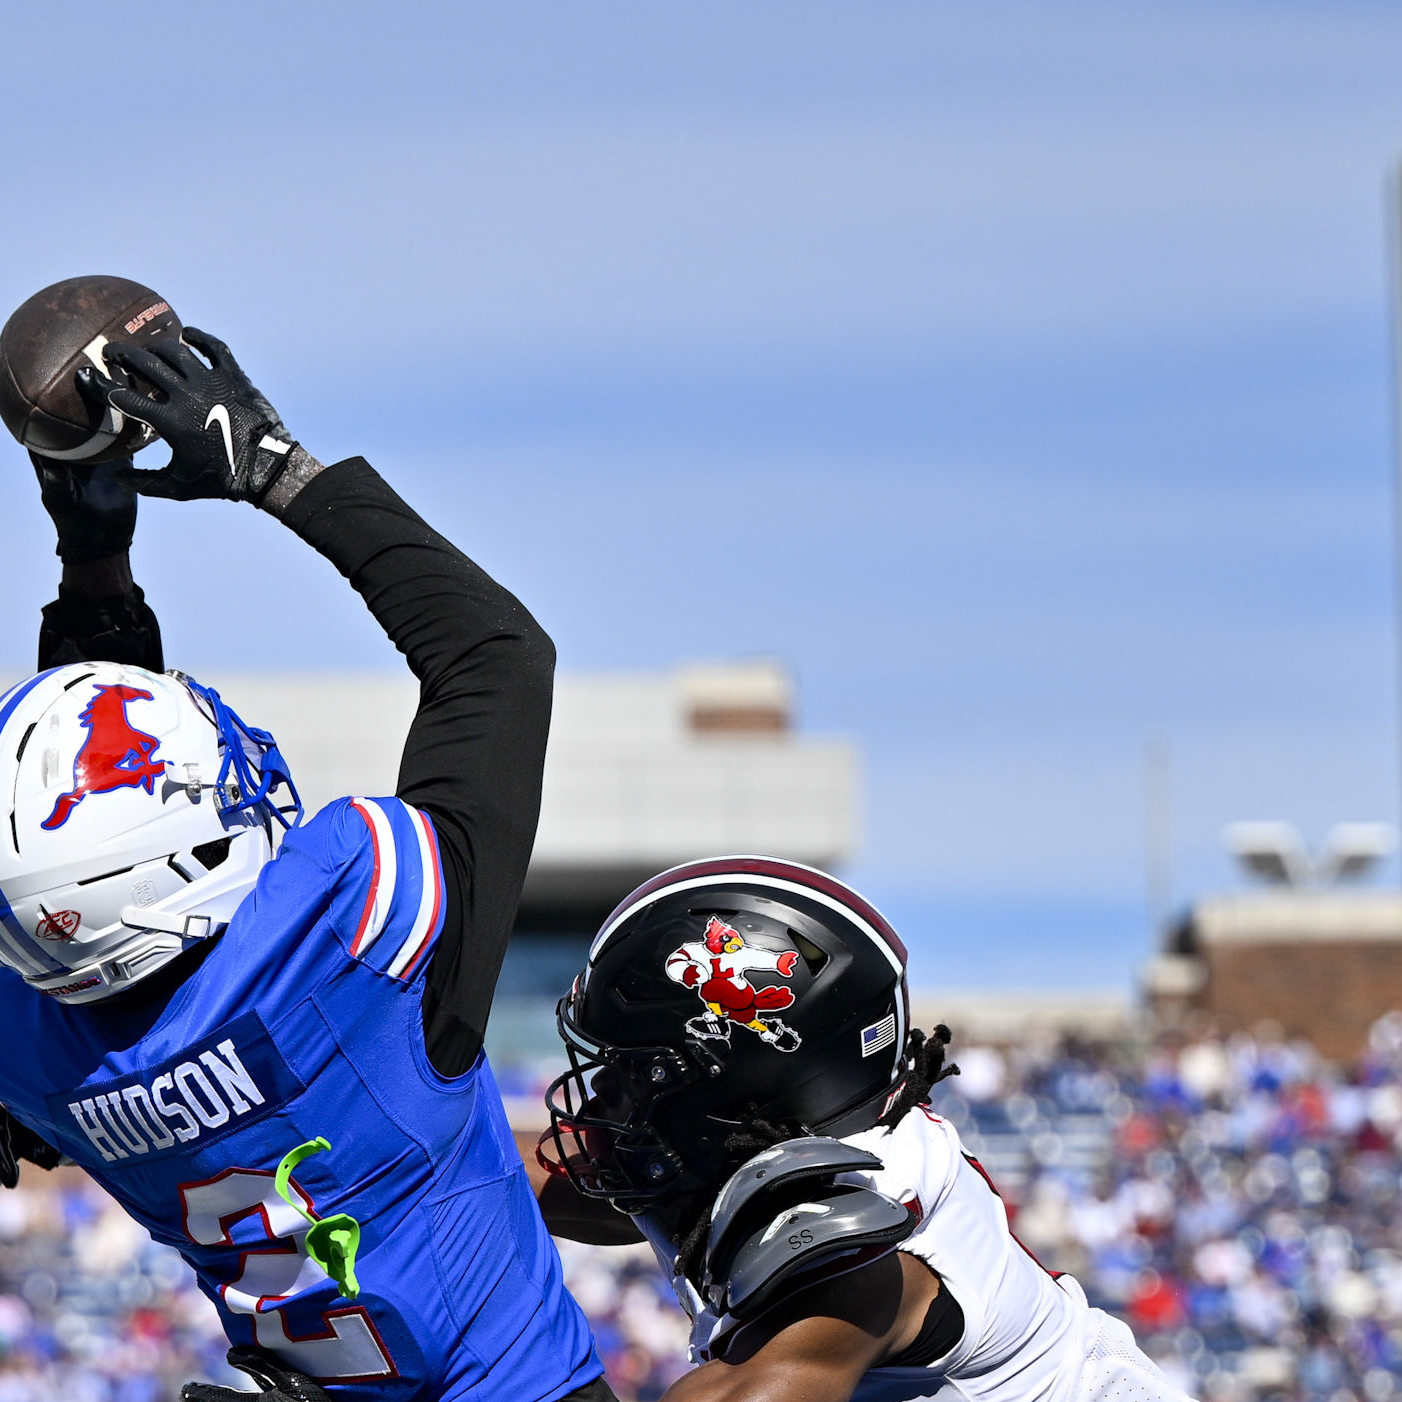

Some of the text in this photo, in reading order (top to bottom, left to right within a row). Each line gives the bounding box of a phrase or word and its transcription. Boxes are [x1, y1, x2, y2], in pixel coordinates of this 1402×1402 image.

[68, 1038, 266, 1162] HUDSON
[178, 1167, 401, 1384] 2
[788, 1229, 814, 1250] SS
